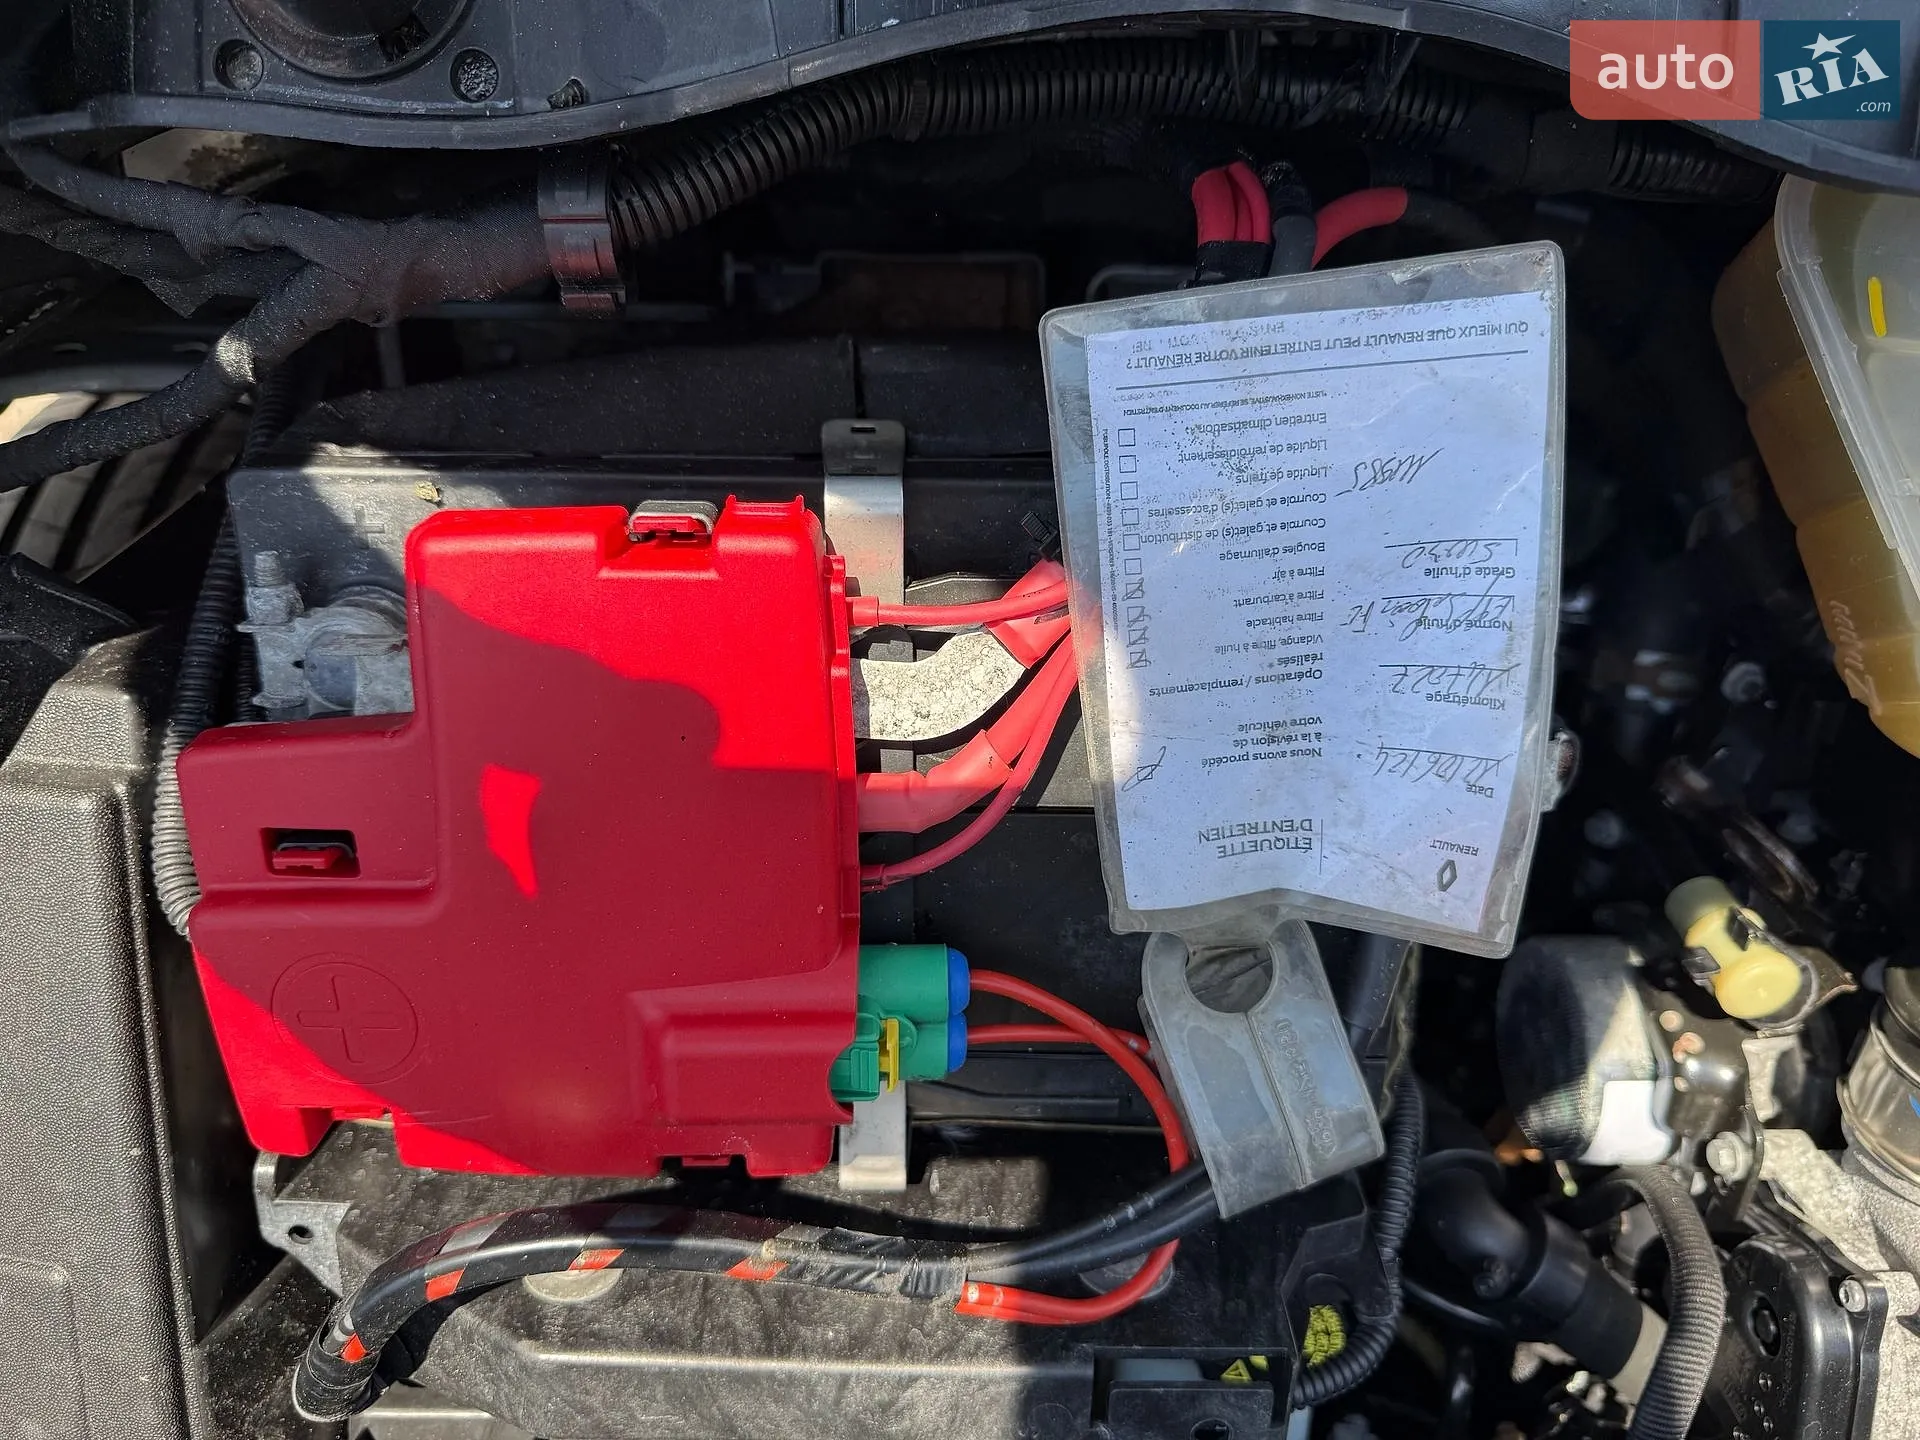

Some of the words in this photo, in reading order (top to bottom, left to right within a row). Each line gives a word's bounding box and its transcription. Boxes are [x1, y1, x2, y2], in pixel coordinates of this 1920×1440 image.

[1427, 328, 1456, 341] QUE
[1459, 323, 1502, 338] MIEUX
[1505, 321, 1529, 334] QUI
[1324, 336, 1361, 350] PEUT
[1363, 331, 1424, 347] RENAULT
[1195, 348, 1237, 362] VOTRE
[1240, 340, 1321, 359] ENTRETENIR
[1126, 359, 1132, 369] ?
[1134, 352, 1192, 368] RENAULT
[1198, 418, 1272, 436] climatisation
[1274, 413, 1327, 427] Entretien
[1268, 444, 1284, 455] de
[1286, 439, 1327, 454] Liquide
[1178, 445, 1267, 464] refroidissement
[1235, 472, 1268, 486] freins
[1268, 470, 1284, 482] de
[1286, 466, 1328, 480] Liquide
[1221, 497, 1263, 514] galet(s)
[1266, 498, 1278, 508] et
[1279, 492, 1327, 507] Courroie
[1147, 503, 1218, 519] d'accessoires
[1221, 522, 1263, 539] galet(s)
[1265, 523, 1278, 533] et
[1279, 517, 1326, 531] Courroie
[1140, 531, 1202, 546] distribution
[1205, 529, 1218, 539] de
[1219, 546, 1280, 562] d'allumage
[1282, 541, 1325, 554] Bougies
[1271, 570, 1287, 581] air
[1288, 569, 1295, 579] à
[1297, 566, 1325, 577] Filtre
[1424, 567, 1471, 579] d'huile
[1475, 566, 1516, 579] Grade
[1233, 593, 1287, 608] carburant
[1287, 593, 1294, 602] à
[1297, 589, 1324, 601] Filtre
[1246, 615, 1294, 628] habitacle
[1296, 612, 1324, 623] Filtre
[1415, 616, 1461, 630] d'huile
[1464, 619, 1512, 632] Norme
[1243, 642, 1249, 651] à
[1252, 639, 1276, 650] filtre
[1278, 634, 1323, 647] Vidange,
[1214, 644, 1240, 655] huile
[1276, 653, 1323, 669] réalisés
[1255, 667, 1323, 686] Opérations
[1149, 679, 1244, 698] remplacements
[1425, 691, 1505, 711] Kilométrage
[1237, 720, 1288, 734] véhicule
[1290, 716, 1322, 728] votre
[1232, 738, 1248, 749] de
[1251, 734, 1298, 747] révision
[1300, 733, 1311, 743] la
[1313, 732, 1322, 742] à
[1252, 750, 1287, 760] avons
[1289, 747, 1322, 758] Nous
[1201, 752, 1250, 768] procédé
[1465, 784, 1494, 798] Date
[1198, 818, 1313, 843] D'ENTRETIEN
[1217, 837, 1313, 859] ÉTIQUETTE
[1430, 840, 1479, 856] RENAULT
